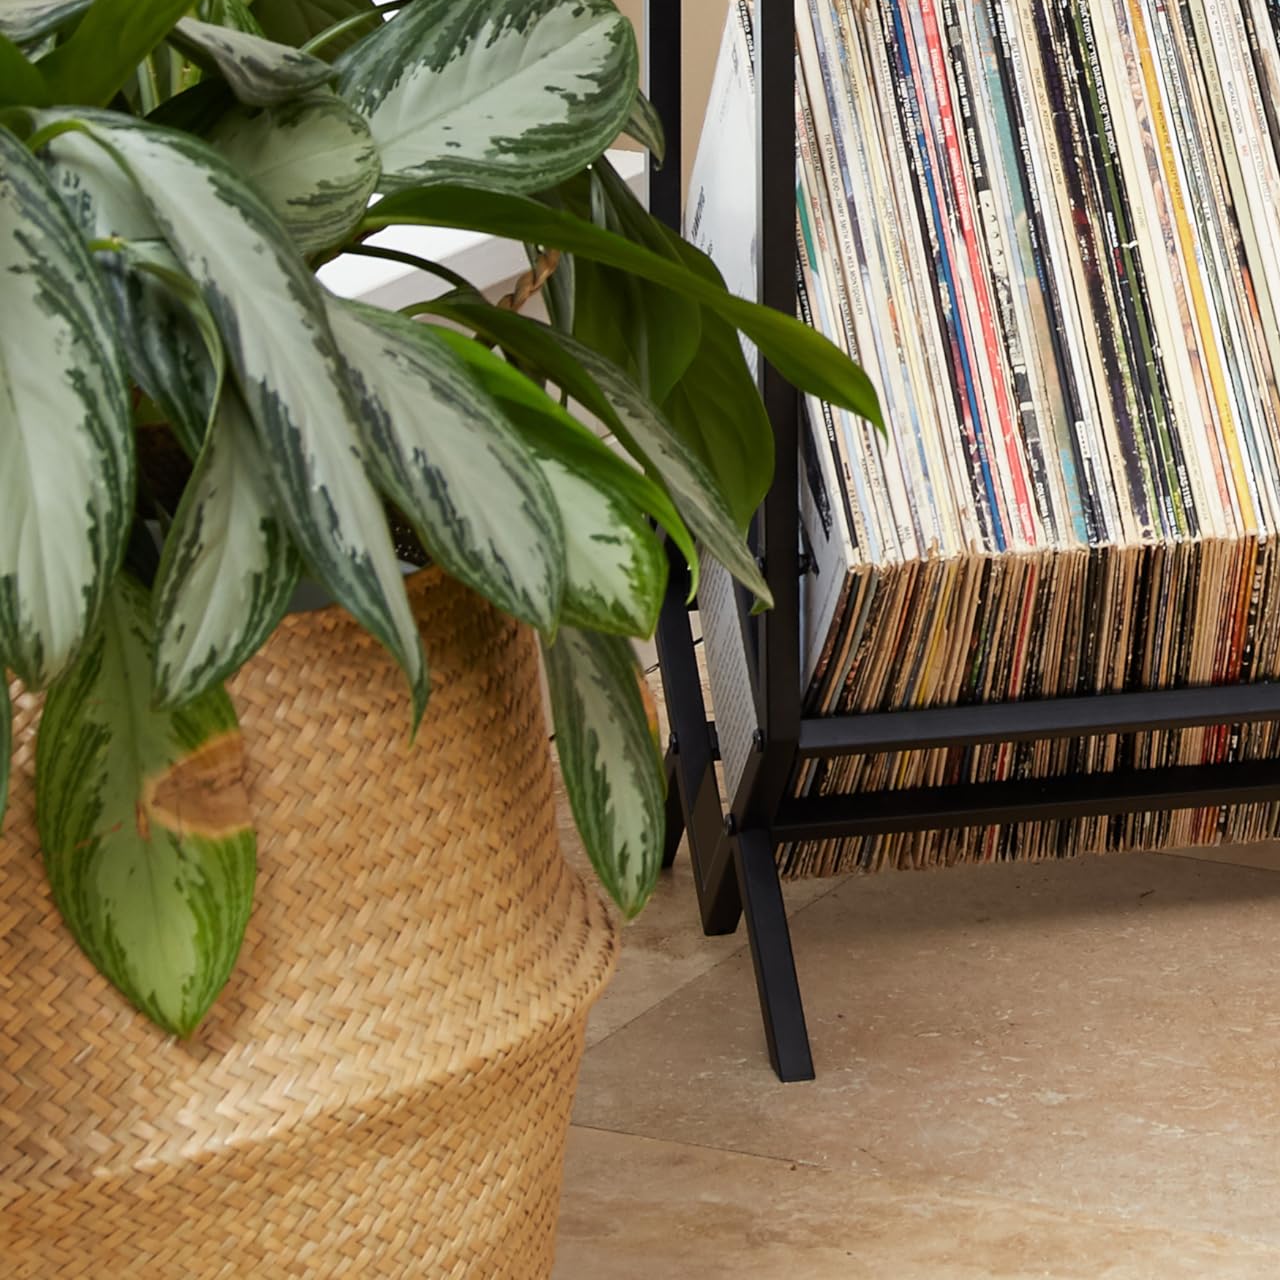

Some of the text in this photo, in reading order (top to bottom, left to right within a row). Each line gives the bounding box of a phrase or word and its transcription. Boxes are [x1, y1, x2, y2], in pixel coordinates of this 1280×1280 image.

[738, 0, 750, 31] STEREO
[1081, 18, 1093, 42] FLOYD
[1088, 52, 1097, 65] THE
[1197, 21, 1207, 44] STEVENS
[1204, 49, 1212, 68] TEASER
[1092, 67, 1101, 86] DARK
[956, 72, 966, 96] YEARS
[961, 97, 970, 116] AFTER
[1096, 87, 1105, 104] SIDE
[1226, 81, 1236, 105] MICHAEL
[1232, 107, 1242, 134] JACKSON
[1100, 105, 1107, 114] OF
[1102, 115, 1111, 130] THE
[1162, 33, 1171, 52] SIMON
[1196, 176, 1206, 202] MORNING
[966, 128, 982, 177] RECORDED LIVE
[1017, 127, 1026, 144] SEALS
[1022, 150, 1032, 172] CROFTS
[1105, 131, 1116, 153] MOON
[826, 147, 836, 175] DYNAMIC
[836, 197, 845, 217] JIMMY
[811, 197, 826, 251] ABC RECORDS
[840, 219, 848, 239] SMITH
[843, 241, 851, 254] AND
[846, 255, 854, 268] WES
[849, 270, 863, 316] MONTGOMERY
[1177, 465, 1192, 507] SMAS 11163
[1035, 482, 1053, 542] COLUMBIA STEREO
